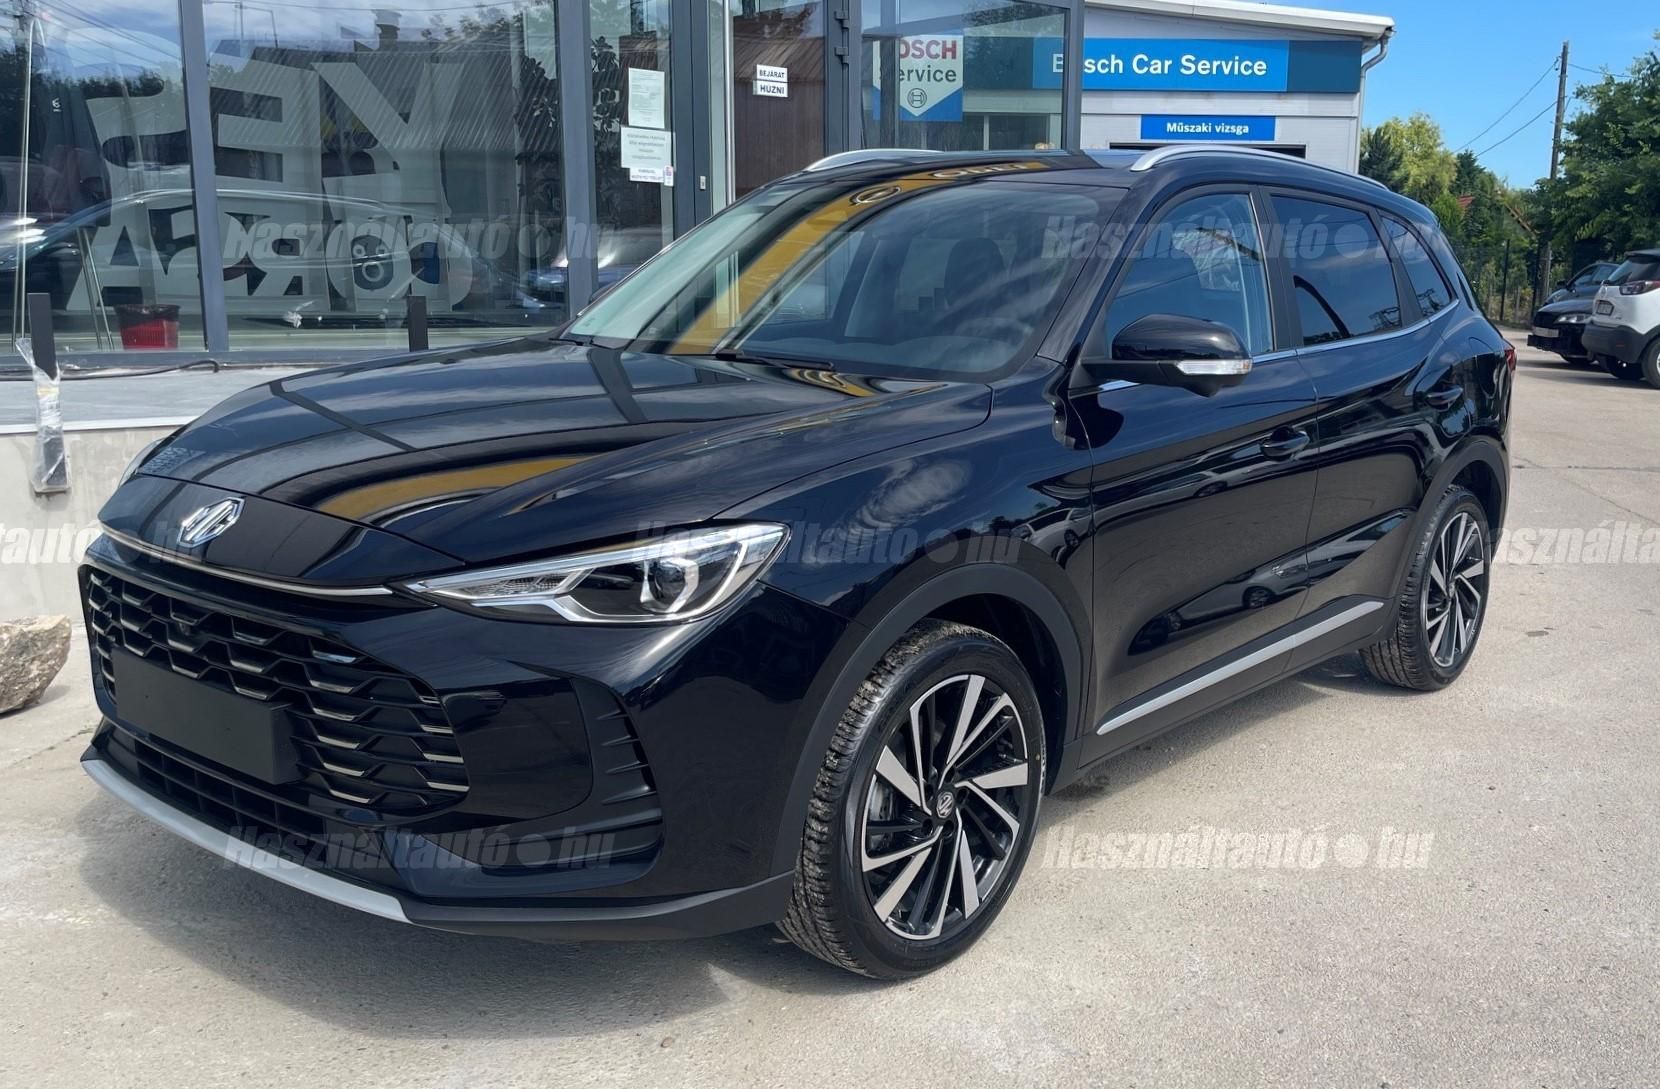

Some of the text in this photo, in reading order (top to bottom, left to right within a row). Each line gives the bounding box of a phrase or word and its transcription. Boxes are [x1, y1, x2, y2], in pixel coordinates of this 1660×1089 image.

[899, 39, 957, 60] OSCH
[899, 64, 957, 83] ervice
[1052, 53, 1268, 76] Bsch Car Service
[1166, 122, 1249, 136] Műszaki vizsga
